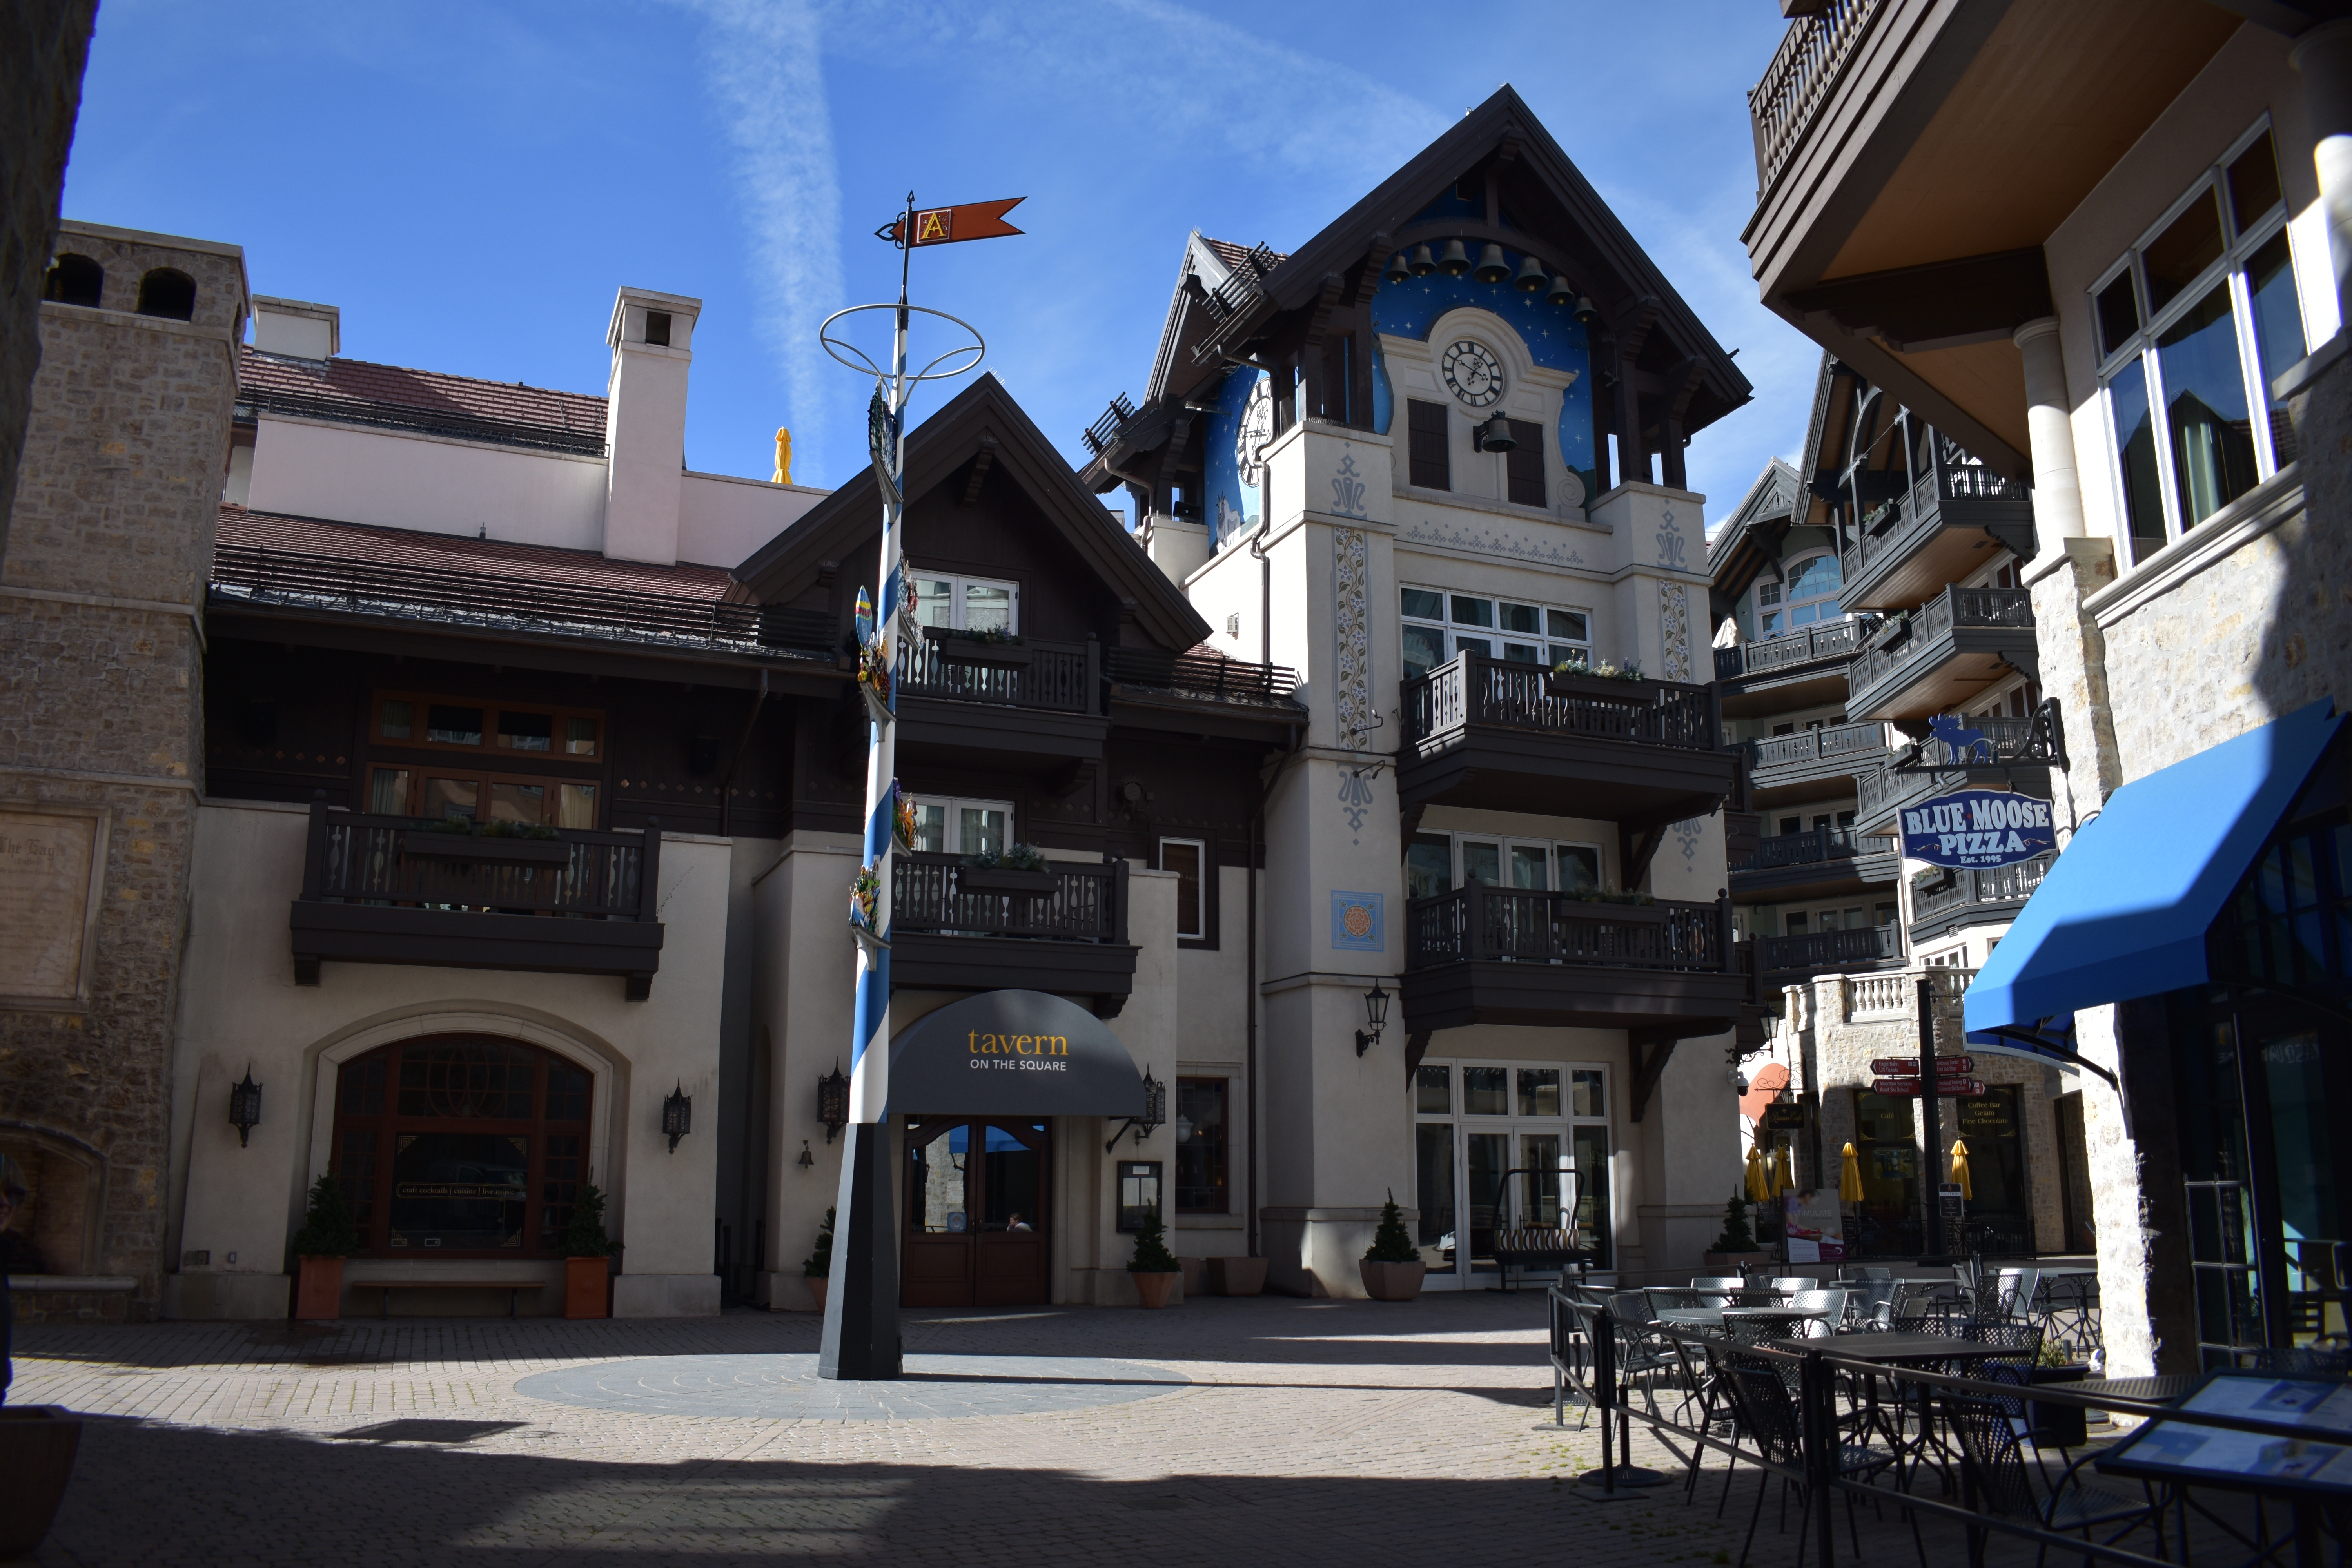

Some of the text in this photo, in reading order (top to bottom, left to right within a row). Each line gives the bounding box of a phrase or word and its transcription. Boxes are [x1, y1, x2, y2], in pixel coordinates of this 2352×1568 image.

[920, 213, 947, 240] A
[1904, 799, 2050, 835] BLUE MOOSE
[1938, 831, 2026, 856] PIZZA
[1980, 855, 2002, 863] 1995
[968, 1029, 1068, 1055] tavern
[970, 1059, 1067, 1071] ON THE SQUARE
[1768, 1111, 1789, 1123] Rimini
